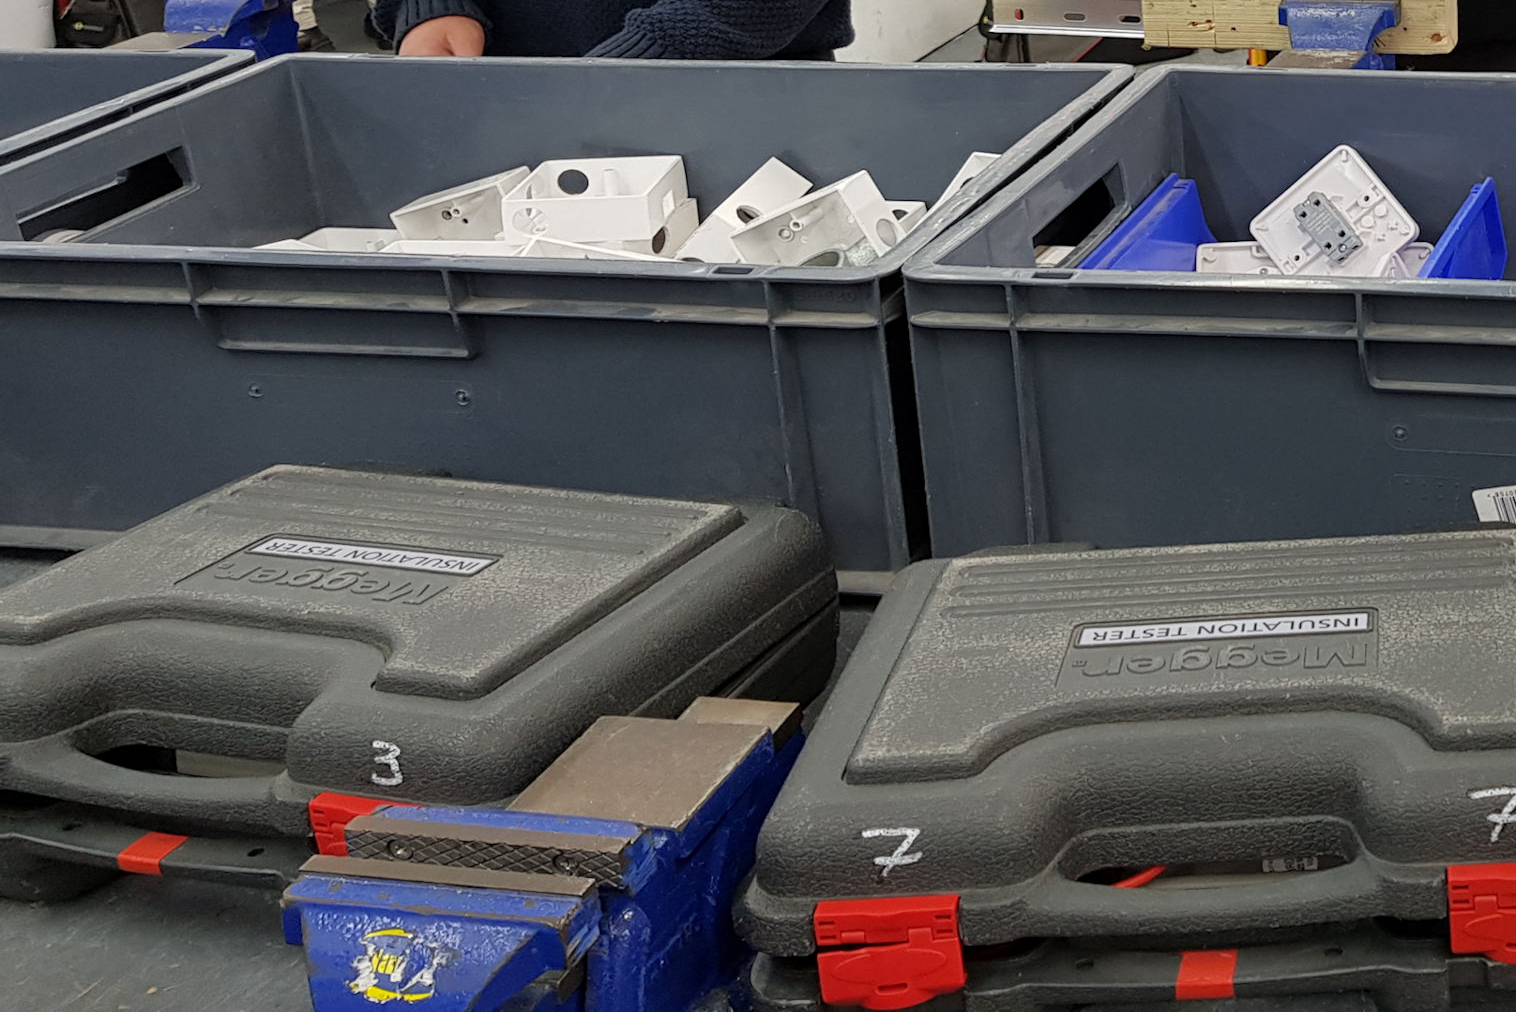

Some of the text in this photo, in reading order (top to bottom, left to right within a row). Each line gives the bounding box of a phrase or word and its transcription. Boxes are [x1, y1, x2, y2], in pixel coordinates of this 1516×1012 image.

[265, 541, 480, 572] INSULATION TESTER
[215, 565, 450, 606] Megger
[1093, 617, 1359, 641] INSULATION TESTER
[1081, 643, 1368, 677] Megger
[371, 740, 403, 786] 3
[861, 827, 923, 877] 7
